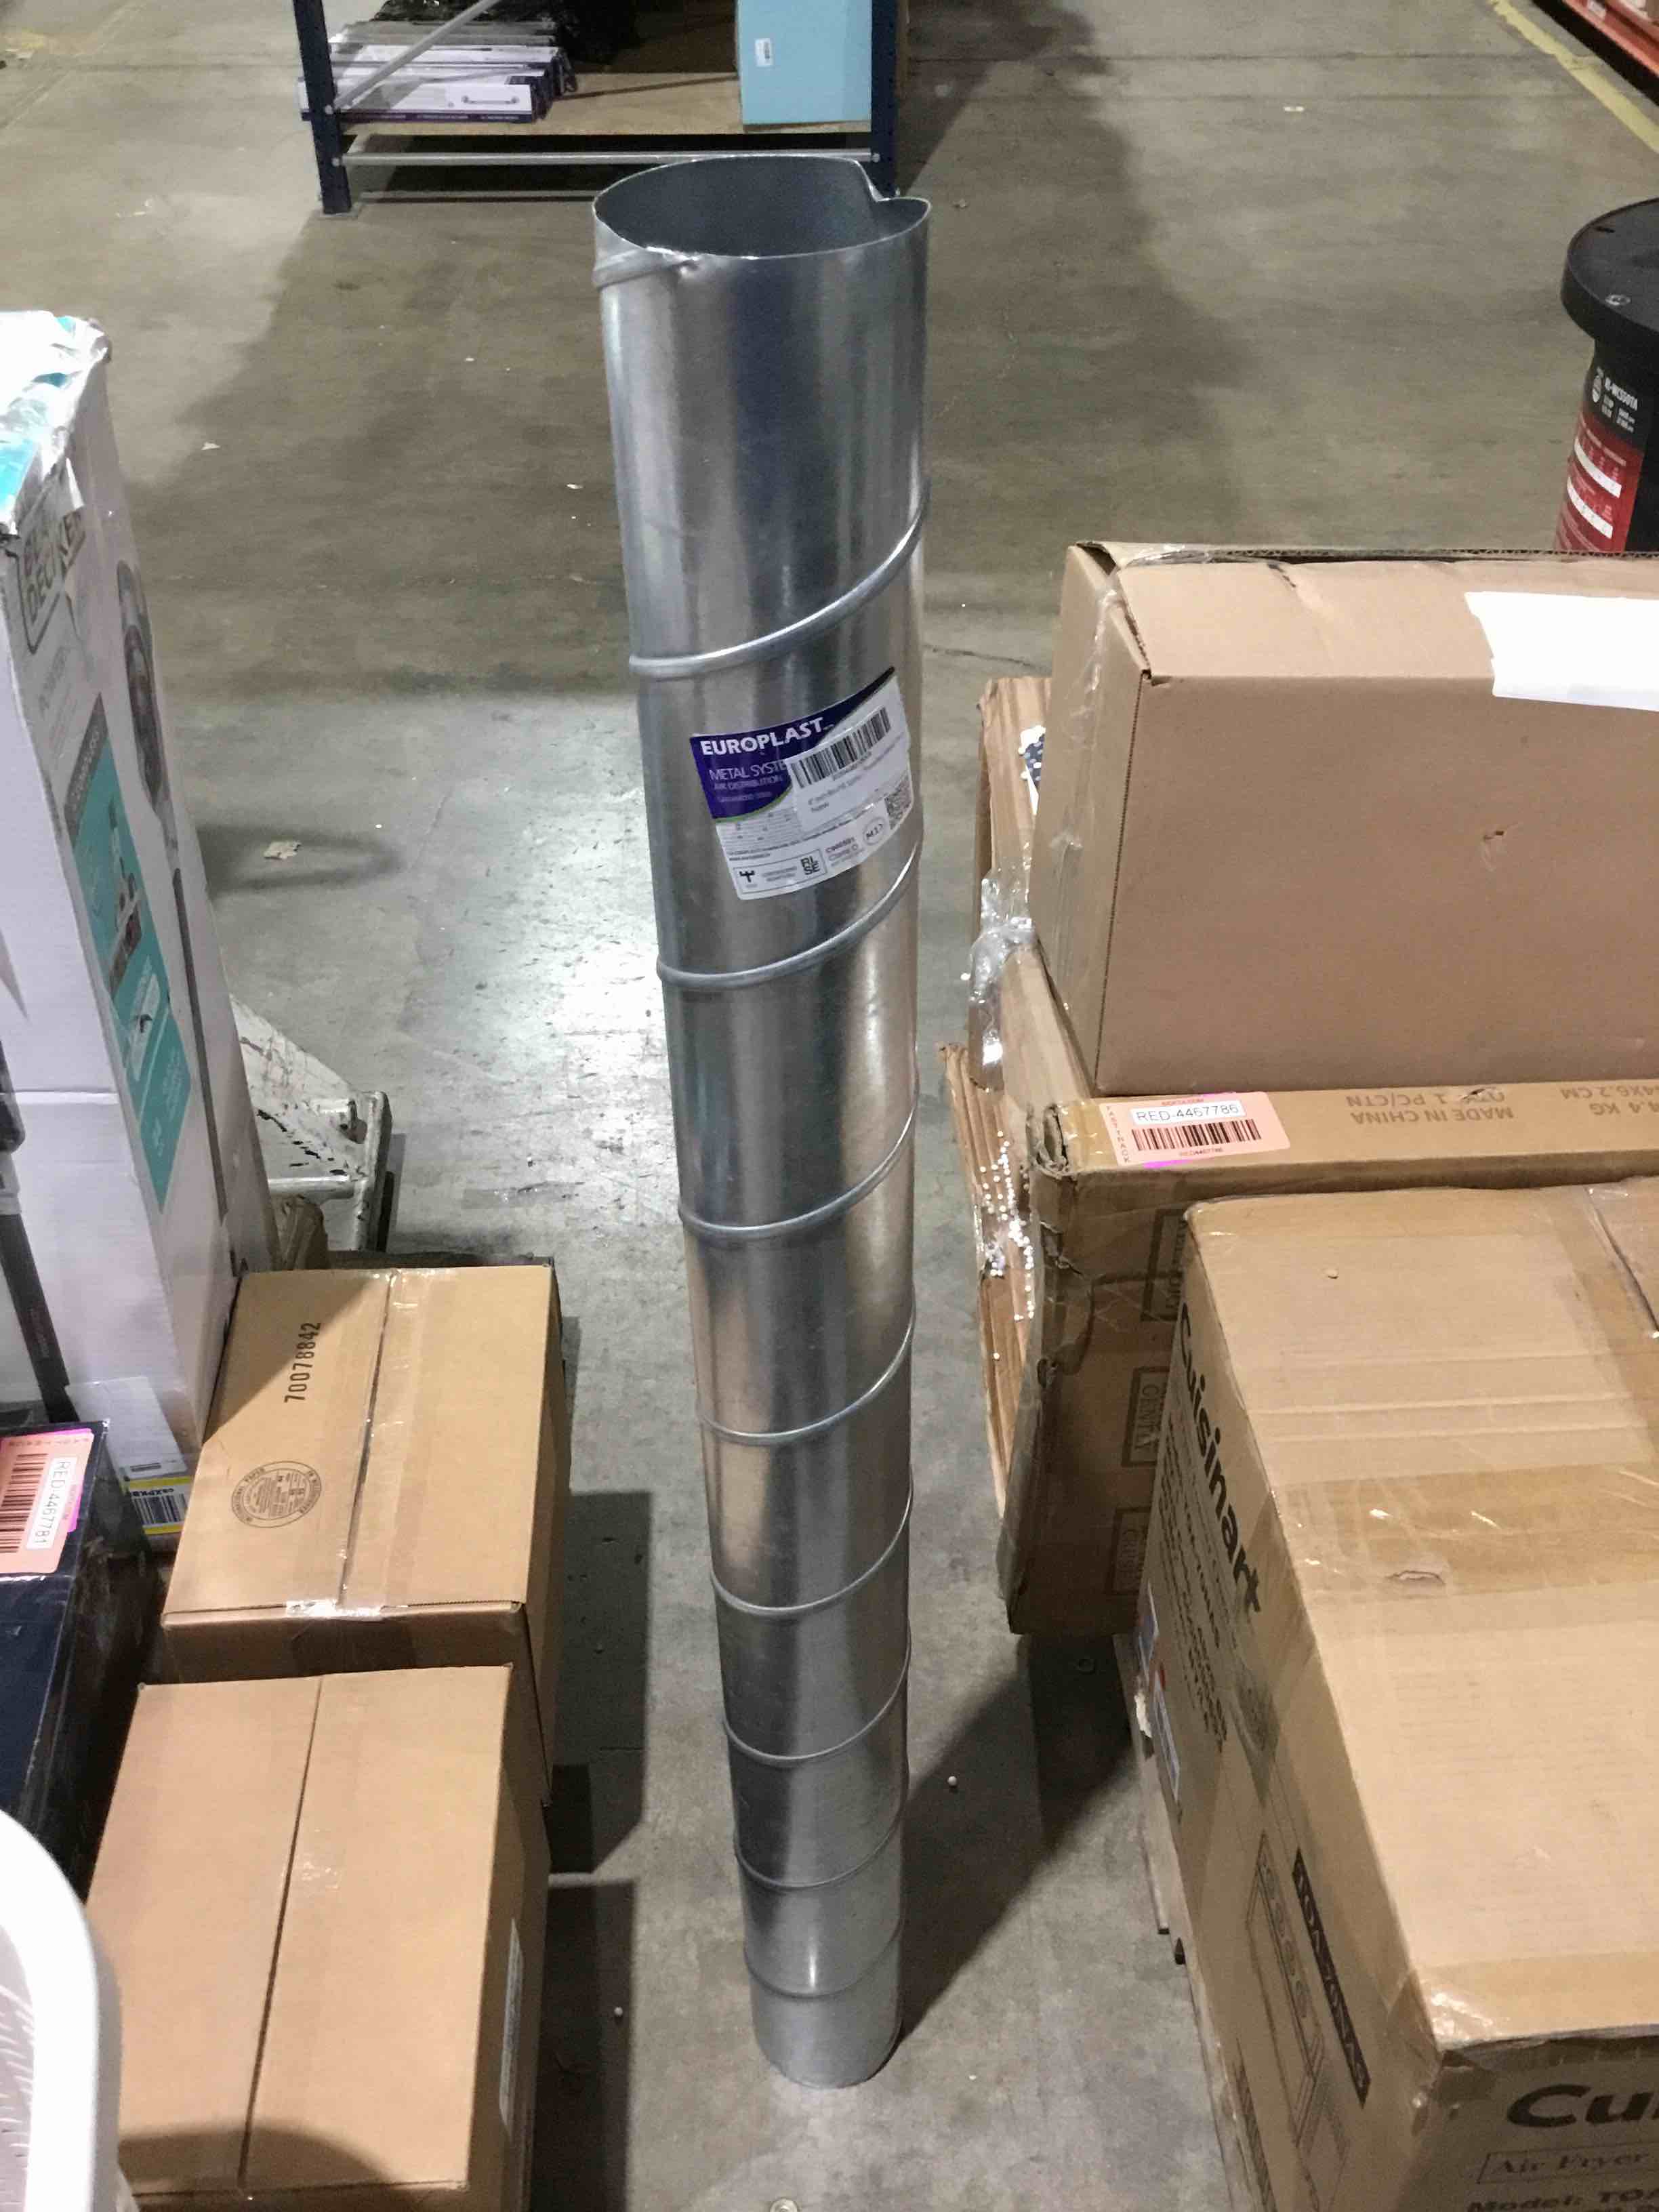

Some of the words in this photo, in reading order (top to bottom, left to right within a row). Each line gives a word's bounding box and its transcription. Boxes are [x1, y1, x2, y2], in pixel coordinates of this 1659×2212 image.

[700, 716, 823, 756] EUROPLAST
[709, 767, 750, 780] METAL
[750, 760, 786, 777] SYSTE
[1561, 1086, 1593, 1100] CM
[1351, 1110, 1420, 1125] CHINA
[1425, 1109, 1448, 1122] IN
[1452, 1106, 1514, 1121] MADE
[1589, 1103, 1621, 1116] KG
[284, 1322, 321, 1403] 70078842
[1181, 1303, 1261, 1612] Cuisinart
[1507, 2084, 1659, 2127] Cu
